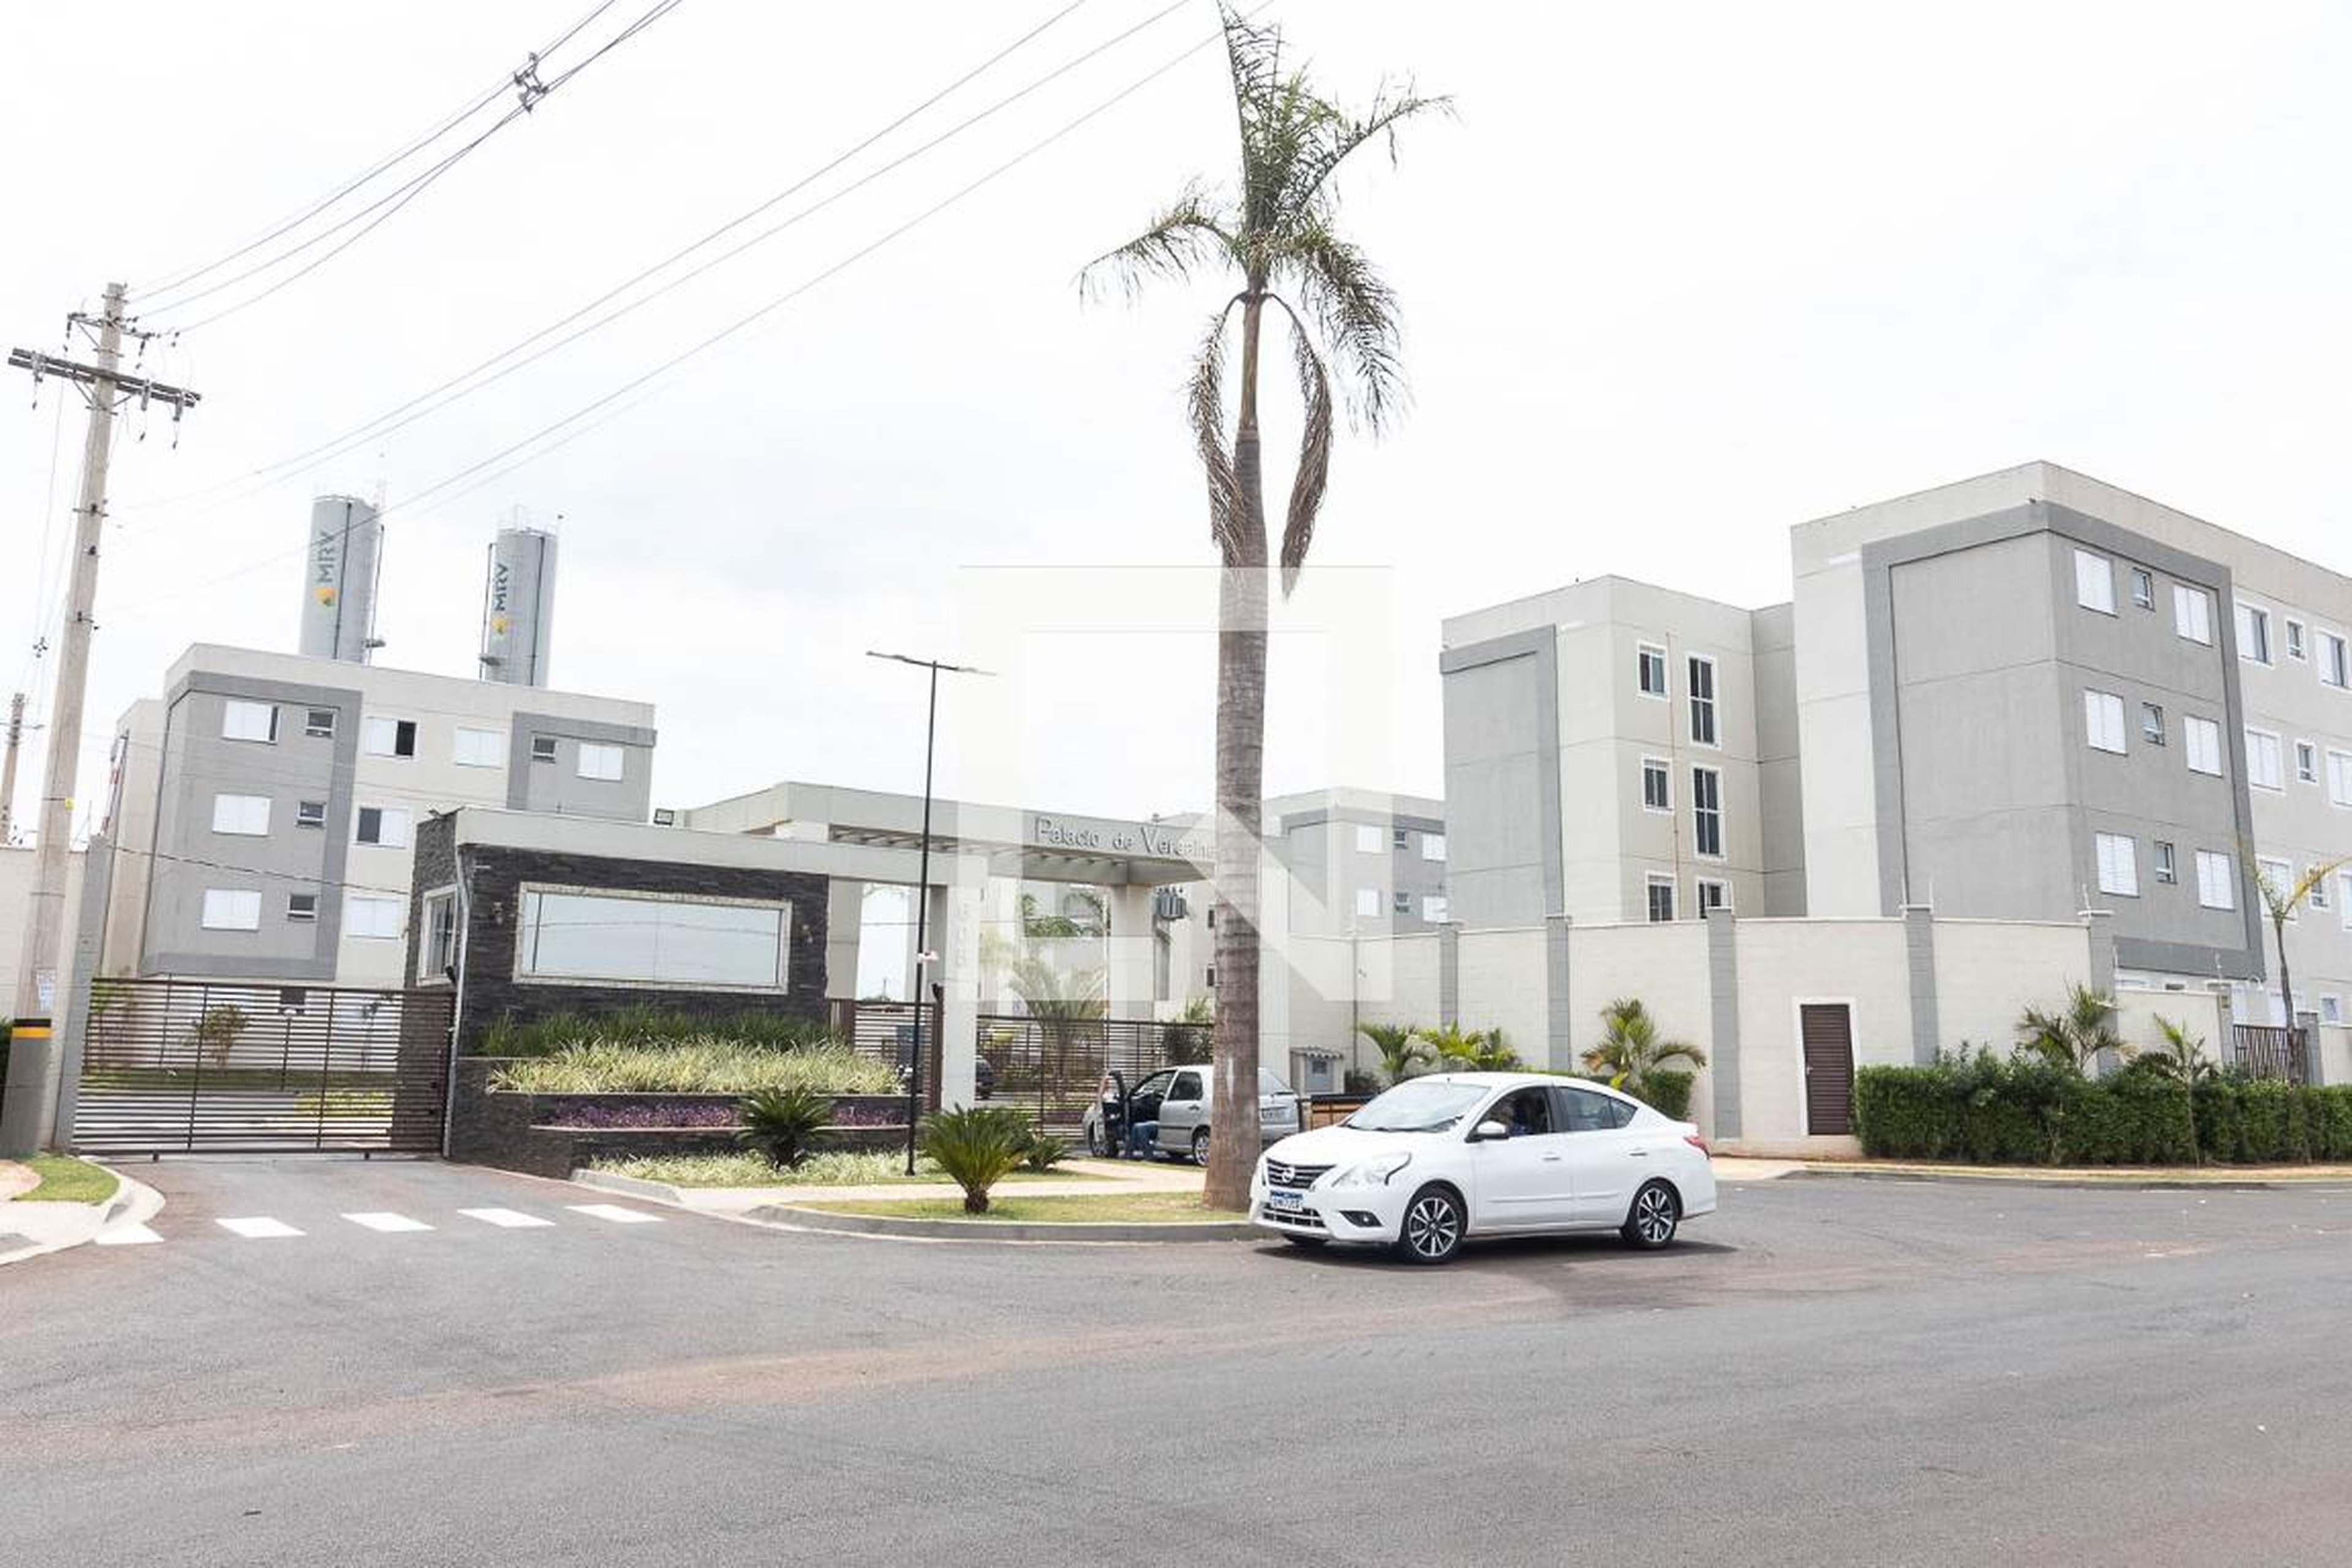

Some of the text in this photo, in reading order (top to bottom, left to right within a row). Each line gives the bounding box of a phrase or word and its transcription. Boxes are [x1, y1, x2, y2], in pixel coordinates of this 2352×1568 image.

[317, 530, 335, 582] MRV
[494, 563, 508, 611] MRV
[1112, 832, 1133, 851] de
